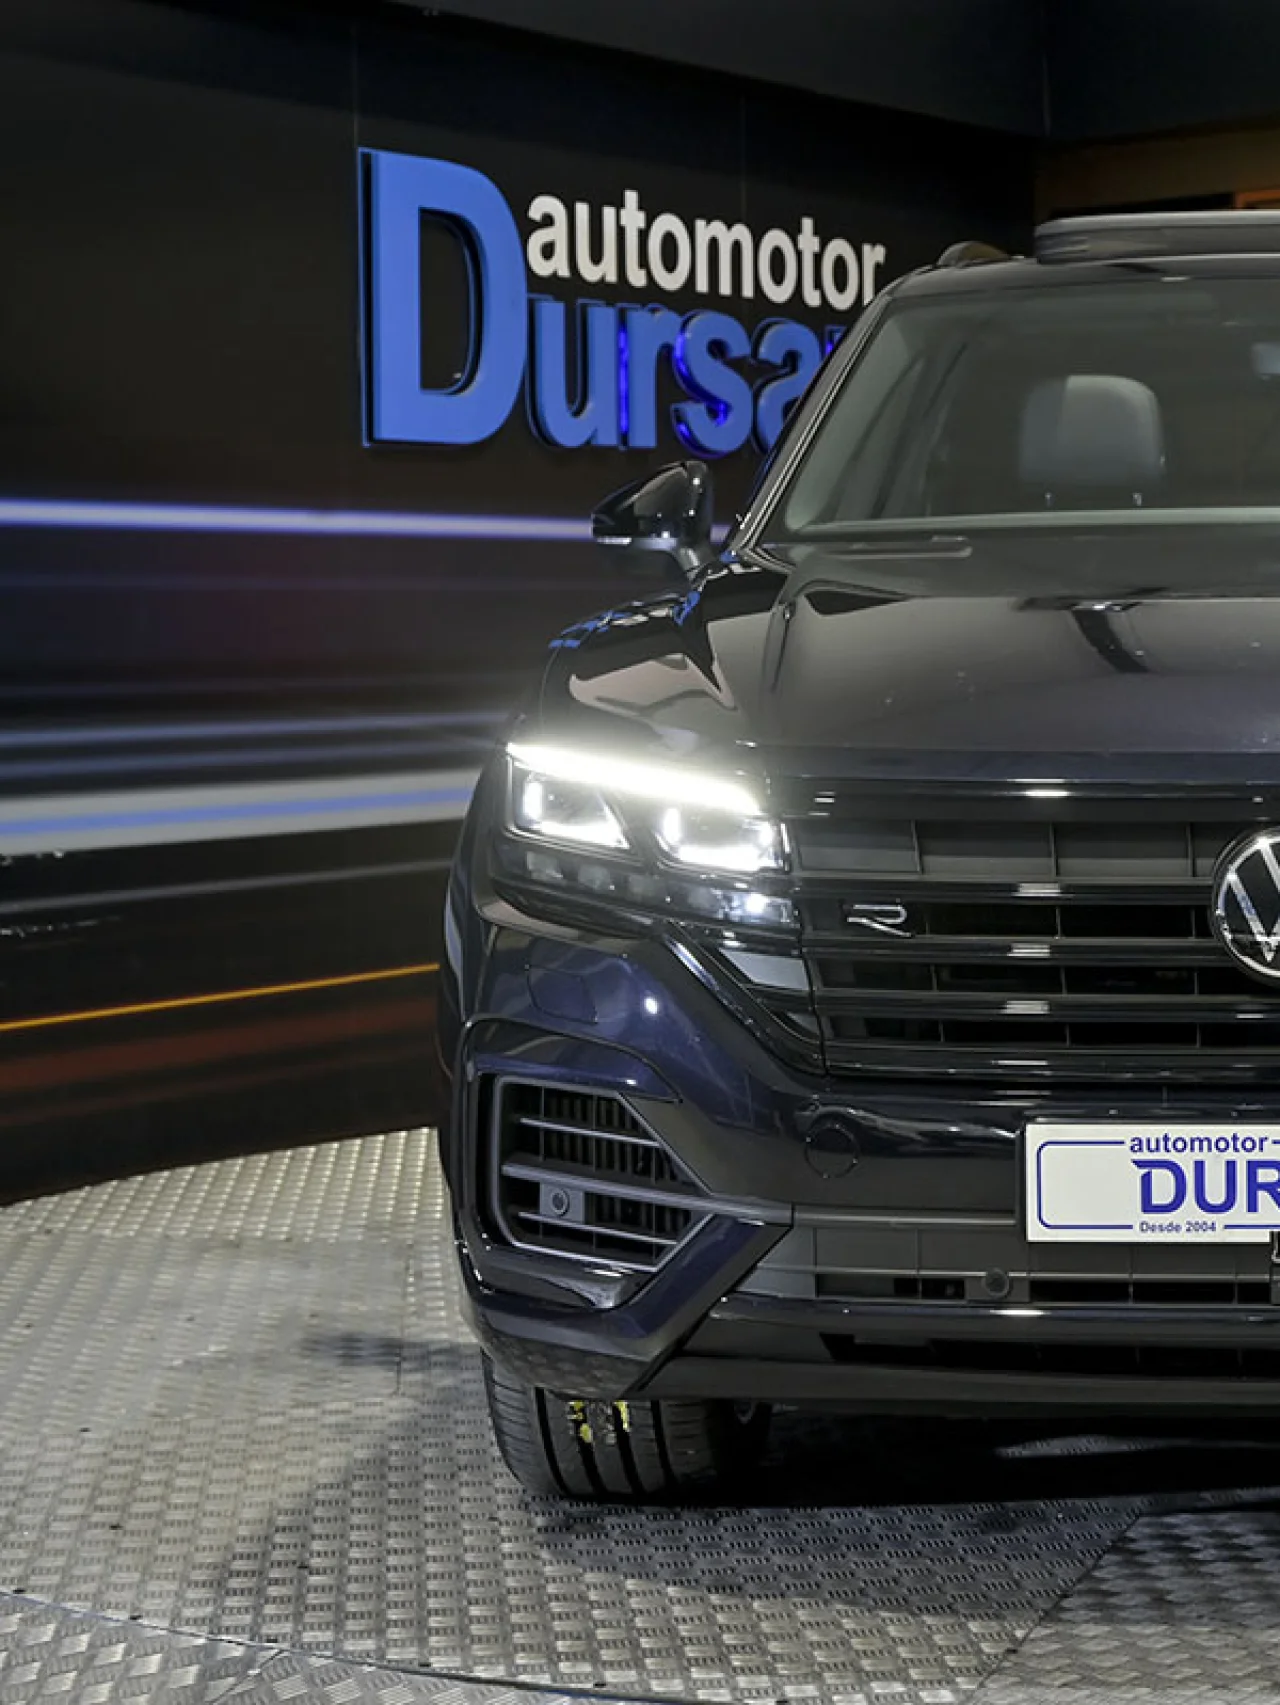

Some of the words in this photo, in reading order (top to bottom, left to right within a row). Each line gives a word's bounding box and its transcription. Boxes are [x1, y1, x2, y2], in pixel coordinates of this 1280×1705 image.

[526, 188, 886, 312] automotor
[357, 146, 848, 456] Dursa
[1129, 1132, 1269, 1153] automotor
[1138, 1220, 1182, 1233] Desde
[1185, 1220, 1217, 1232] 2004
